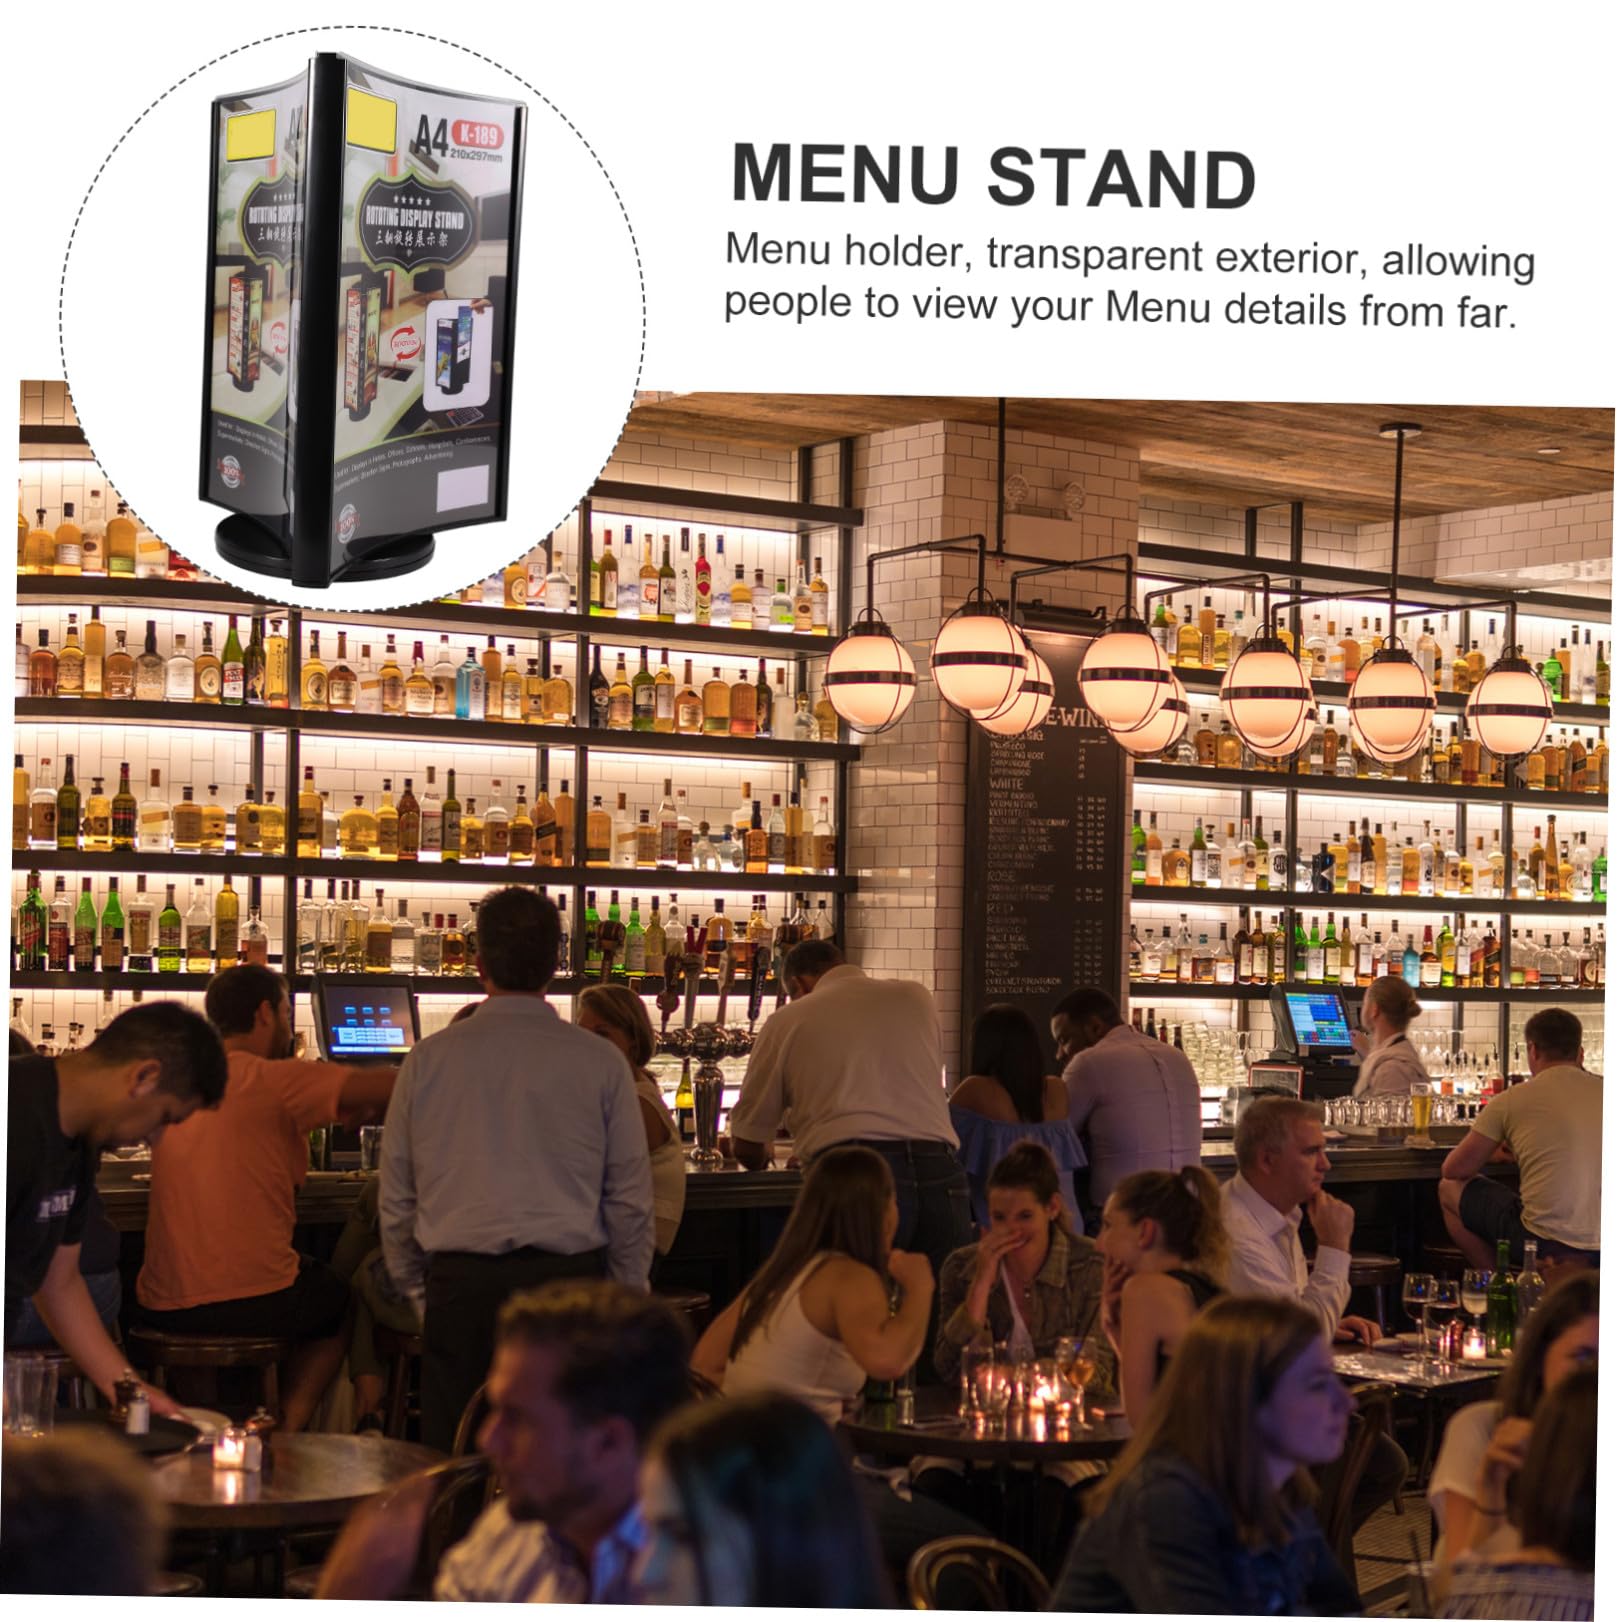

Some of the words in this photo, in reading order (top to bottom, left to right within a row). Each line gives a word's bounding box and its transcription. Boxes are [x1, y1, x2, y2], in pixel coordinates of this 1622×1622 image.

[415, 114, 448, 157] A4
[461, 124, 498, 145] K-189
[450, 149, 503, 162] 210x297mm
[366, 205, 399, 226] ROTATING
[400, 208, 433, 228] DISPLAY
[434, 211, 464, 230] STAND
[989, 778, 1024, 790] WHITE
